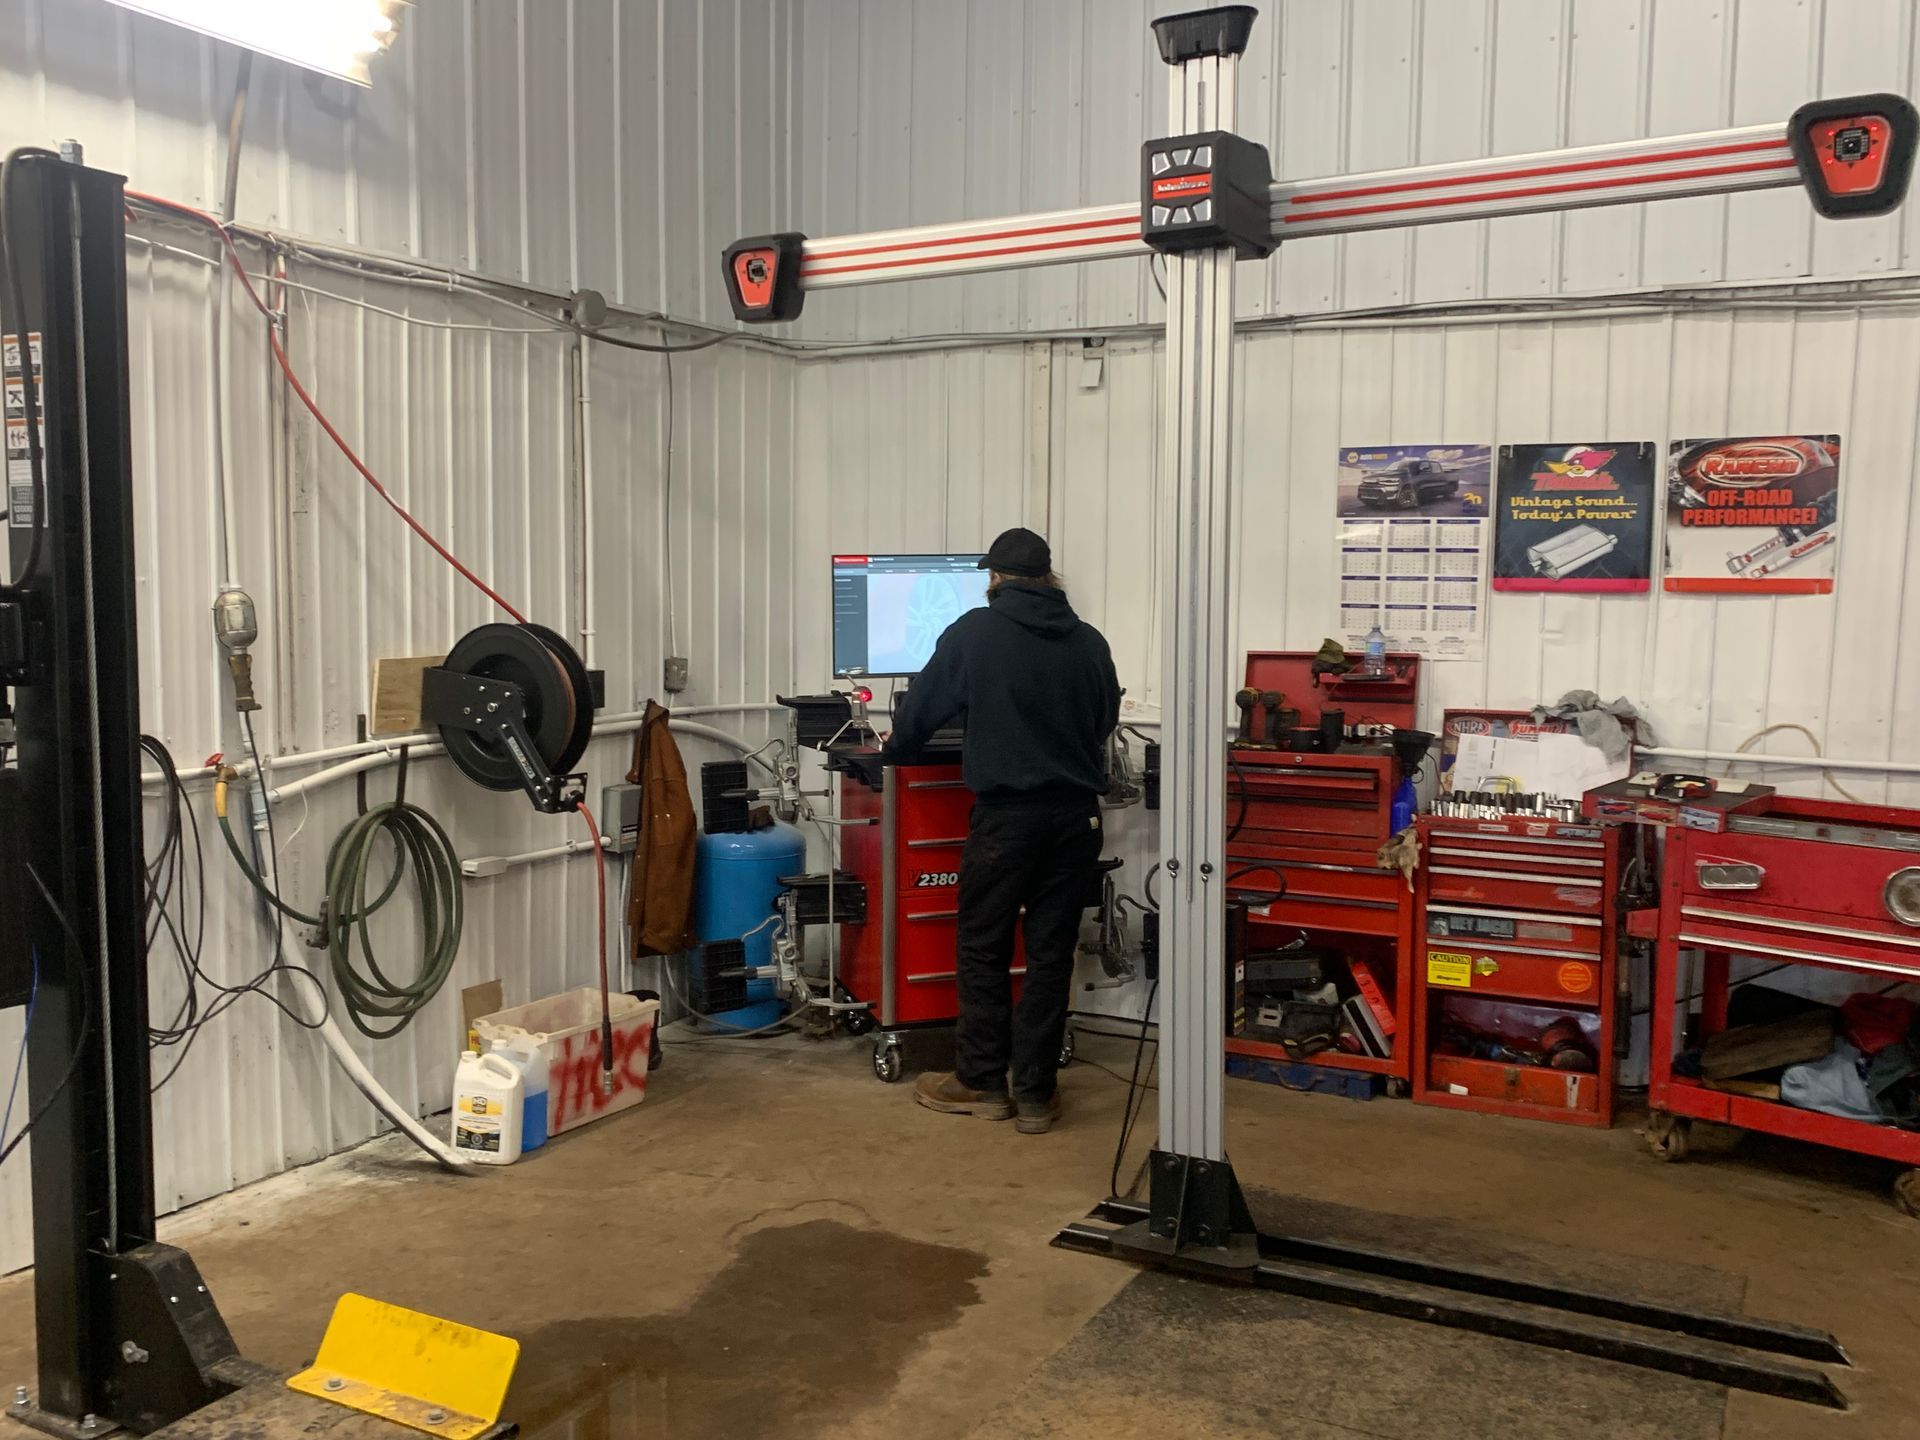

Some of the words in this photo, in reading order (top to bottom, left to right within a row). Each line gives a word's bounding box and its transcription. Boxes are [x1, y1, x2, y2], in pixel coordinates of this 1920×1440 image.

[1704, 457, 1800, 476] RANCHO
[1511, 497, 1573, 508] Vintage
[1707, 489, 1792, 507] OFF-ROAD
[1512, 510, 1575, 522] Today's
[1683, 508, 1818, 526] PERFORMANCE!
[1453, 720, 1483, 733] NHRA
[1431, 953, 1469, 964] CAUTION
